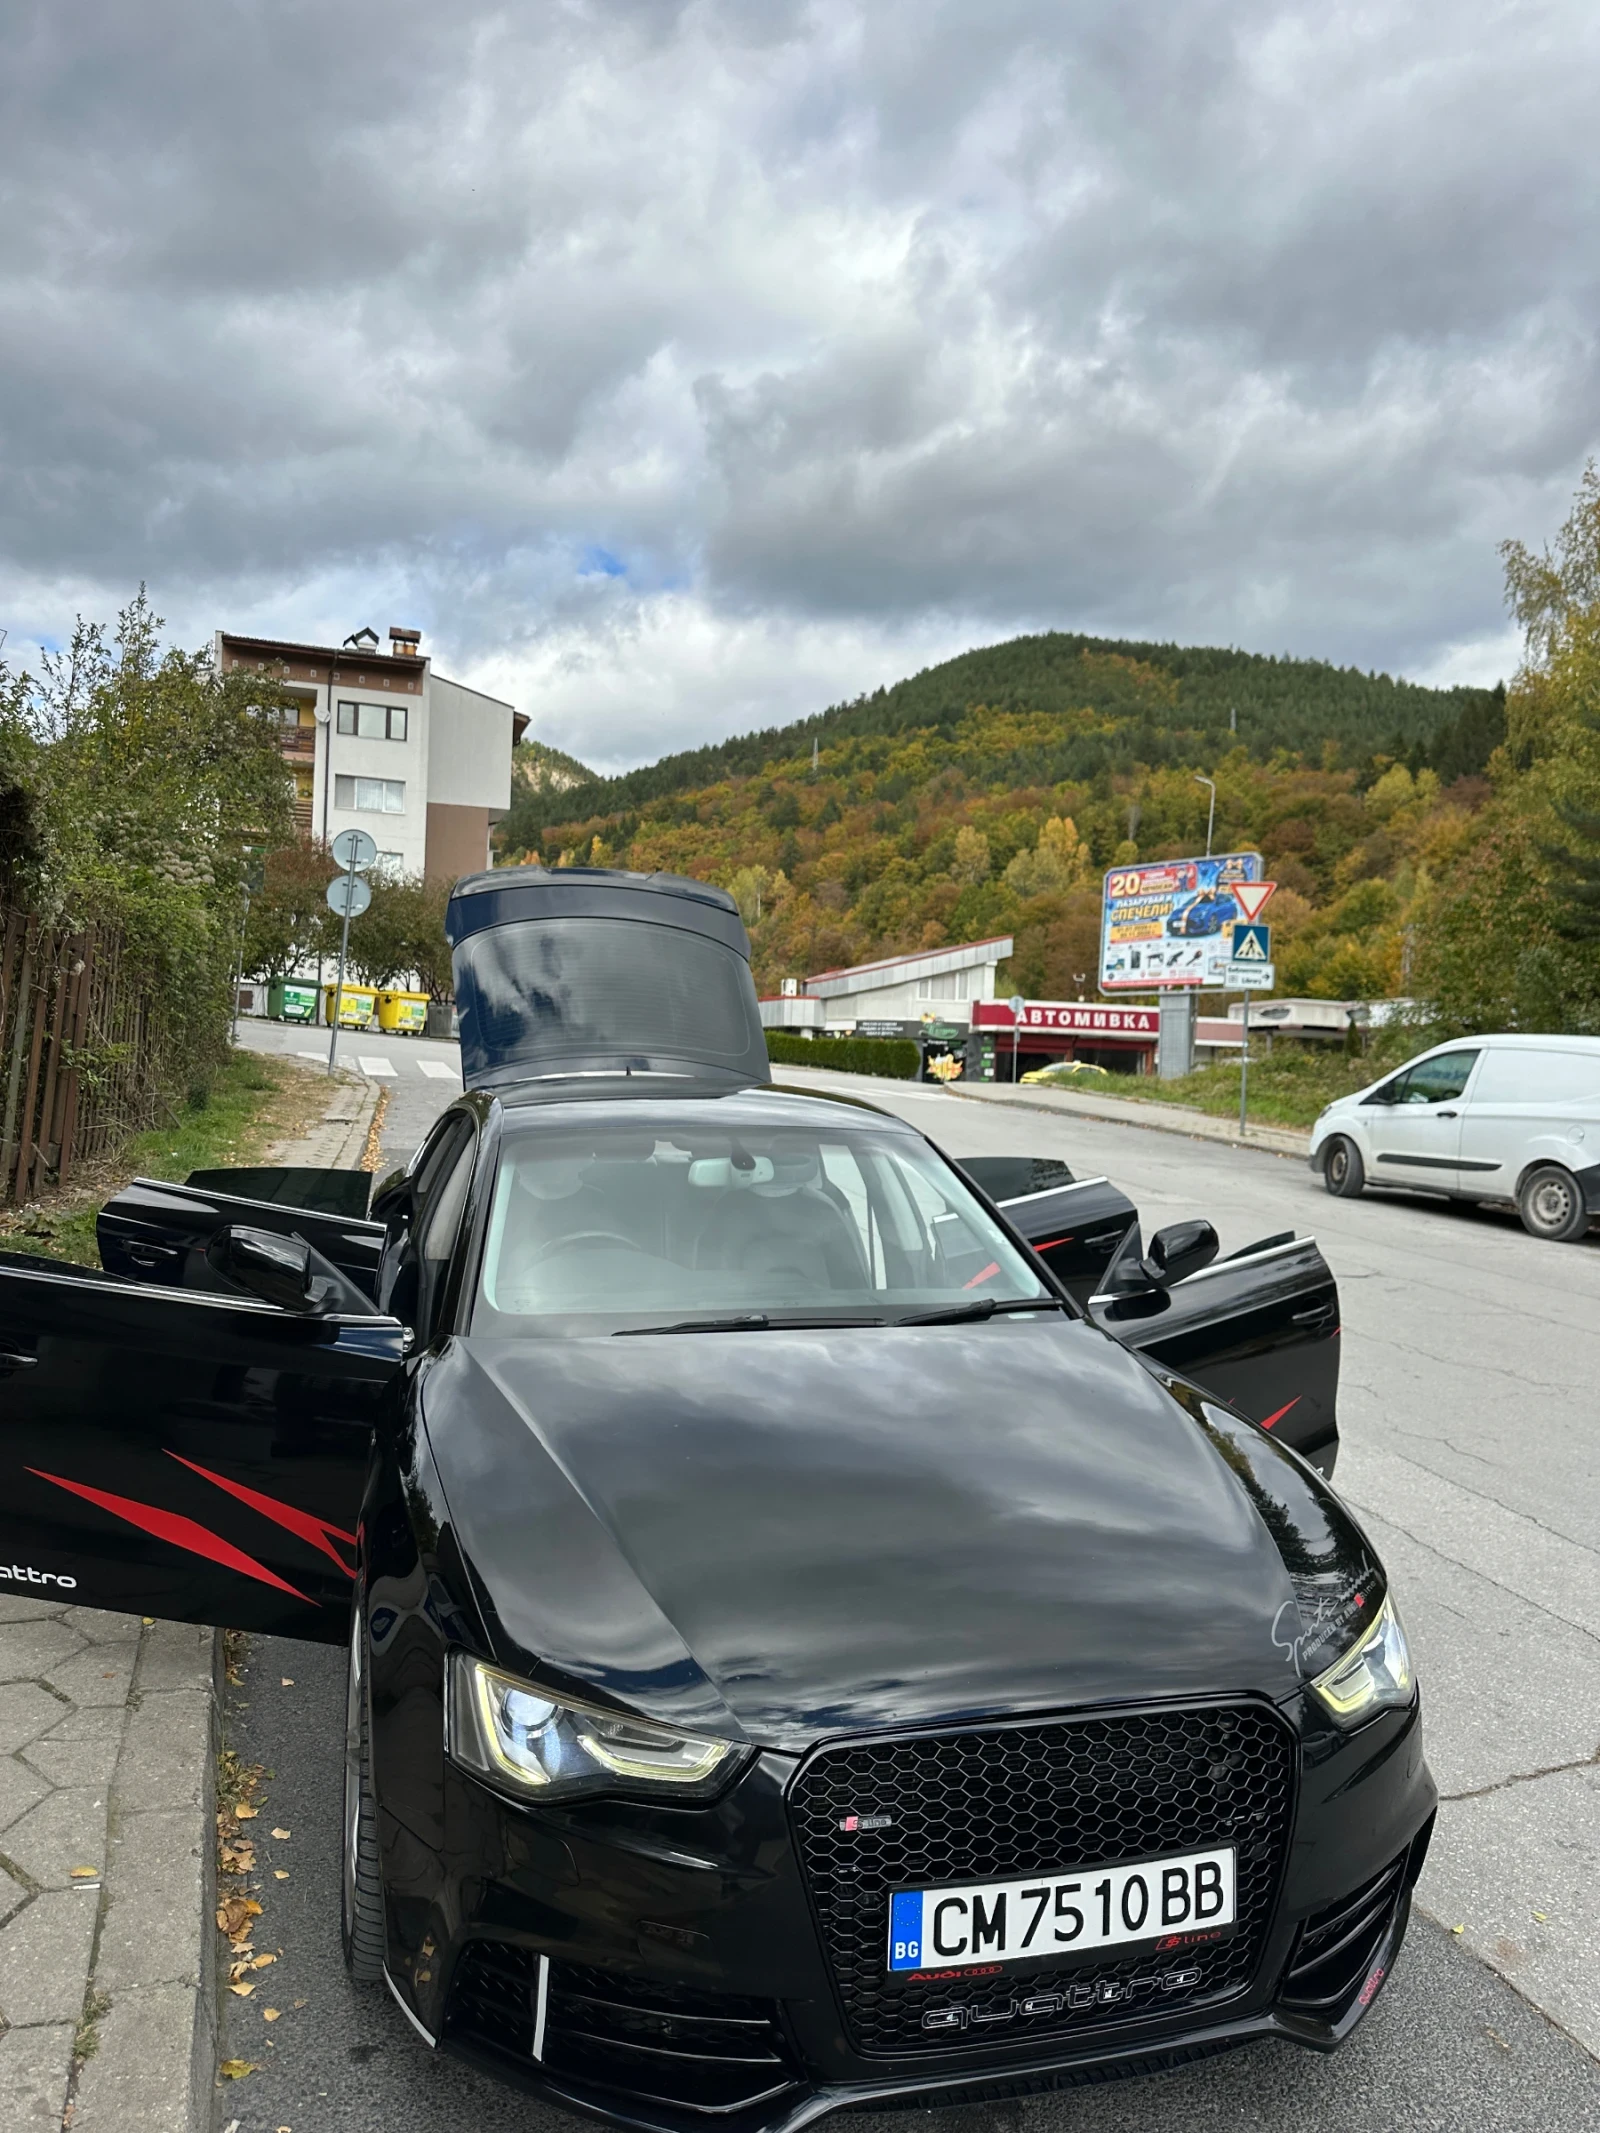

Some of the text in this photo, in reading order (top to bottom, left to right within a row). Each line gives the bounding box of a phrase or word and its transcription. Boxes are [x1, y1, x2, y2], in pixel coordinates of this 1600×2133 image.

[1111, 873, 1140, 897] 20
[1111, 903, 1174, 922] СПЕЧЕЛИ!
[1117, 895, 1165, 908] ПАЗАРУВАЙ
[1016, 1009, 1150, 1029] АВТОМИВКА
[1302, 1626, 1337, 1661] PRODUCED
[1020, 1874, 1149, 1948] 7510
[895, 1941, 919, 1960] BG
[922, 1967, 1202, 2029] quattro
